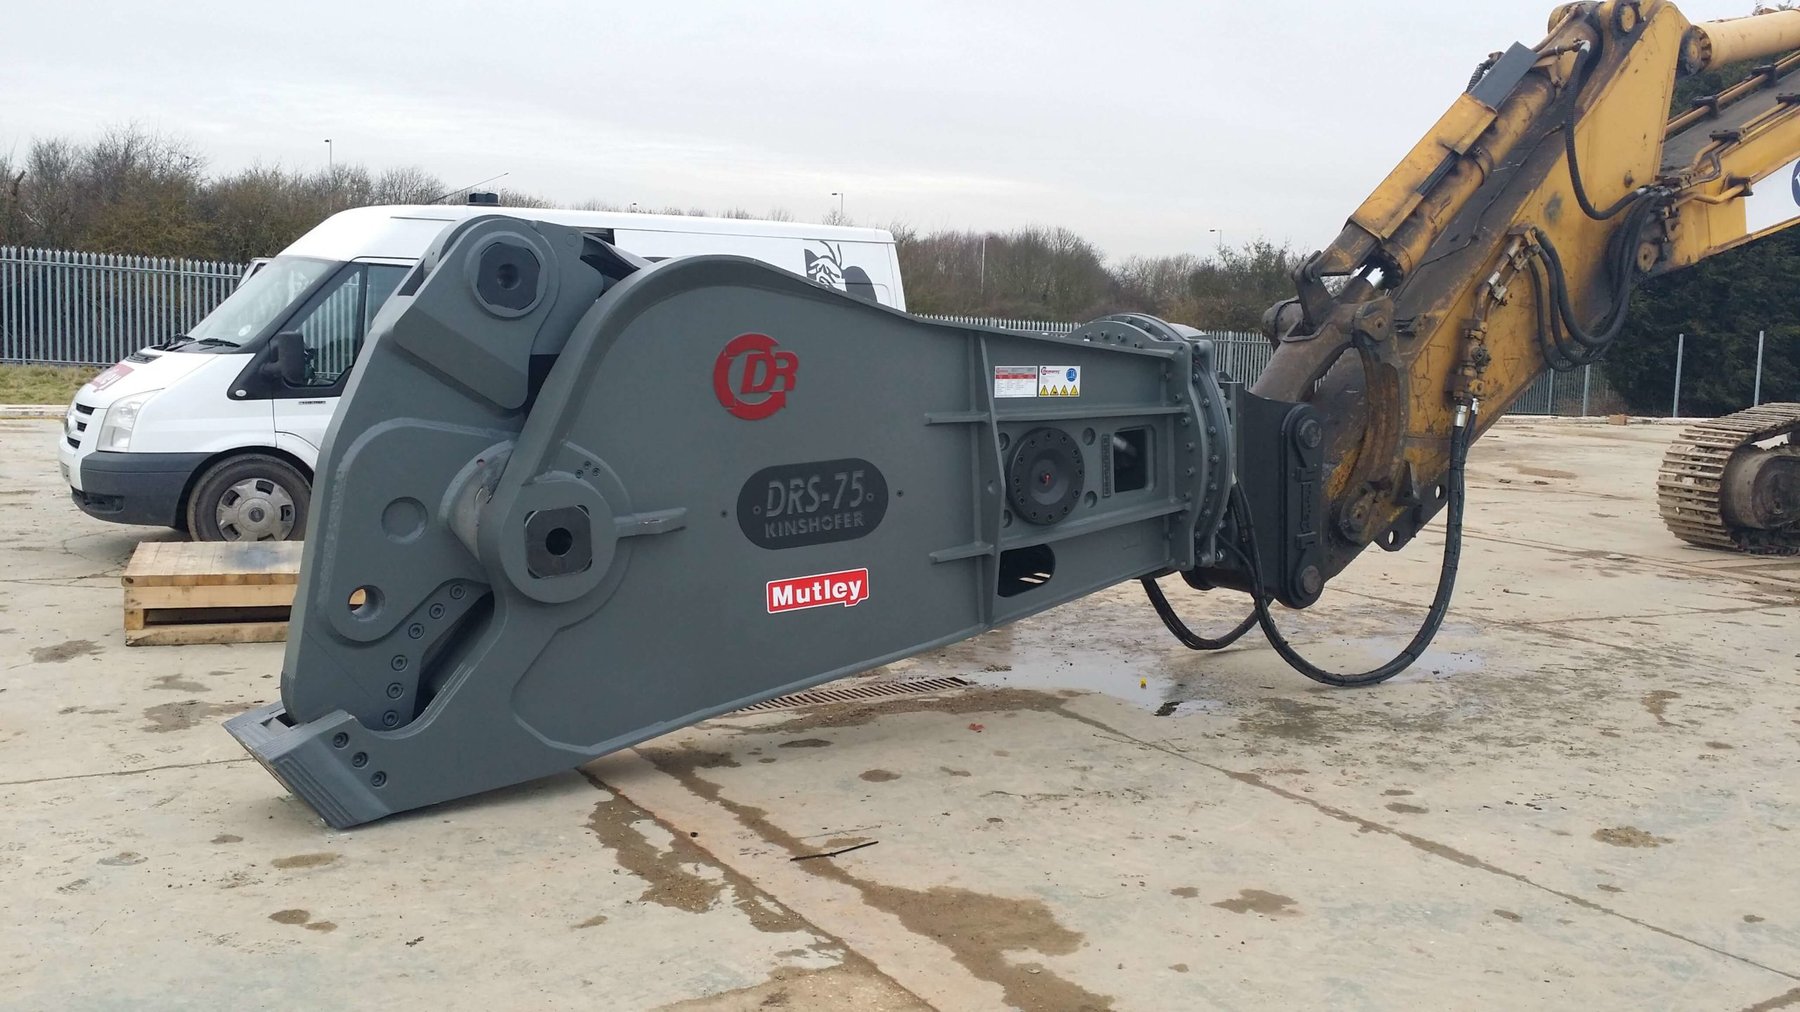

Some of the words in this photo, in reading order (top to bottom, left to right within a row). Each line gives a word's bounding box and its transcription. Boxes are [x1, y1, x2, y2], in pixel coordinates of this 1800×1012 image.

[766, 470, 865, 517] DRS-75
[765, 511, 865, 538] KINSHOFER
[772, 579, 862, 607] Mutley
